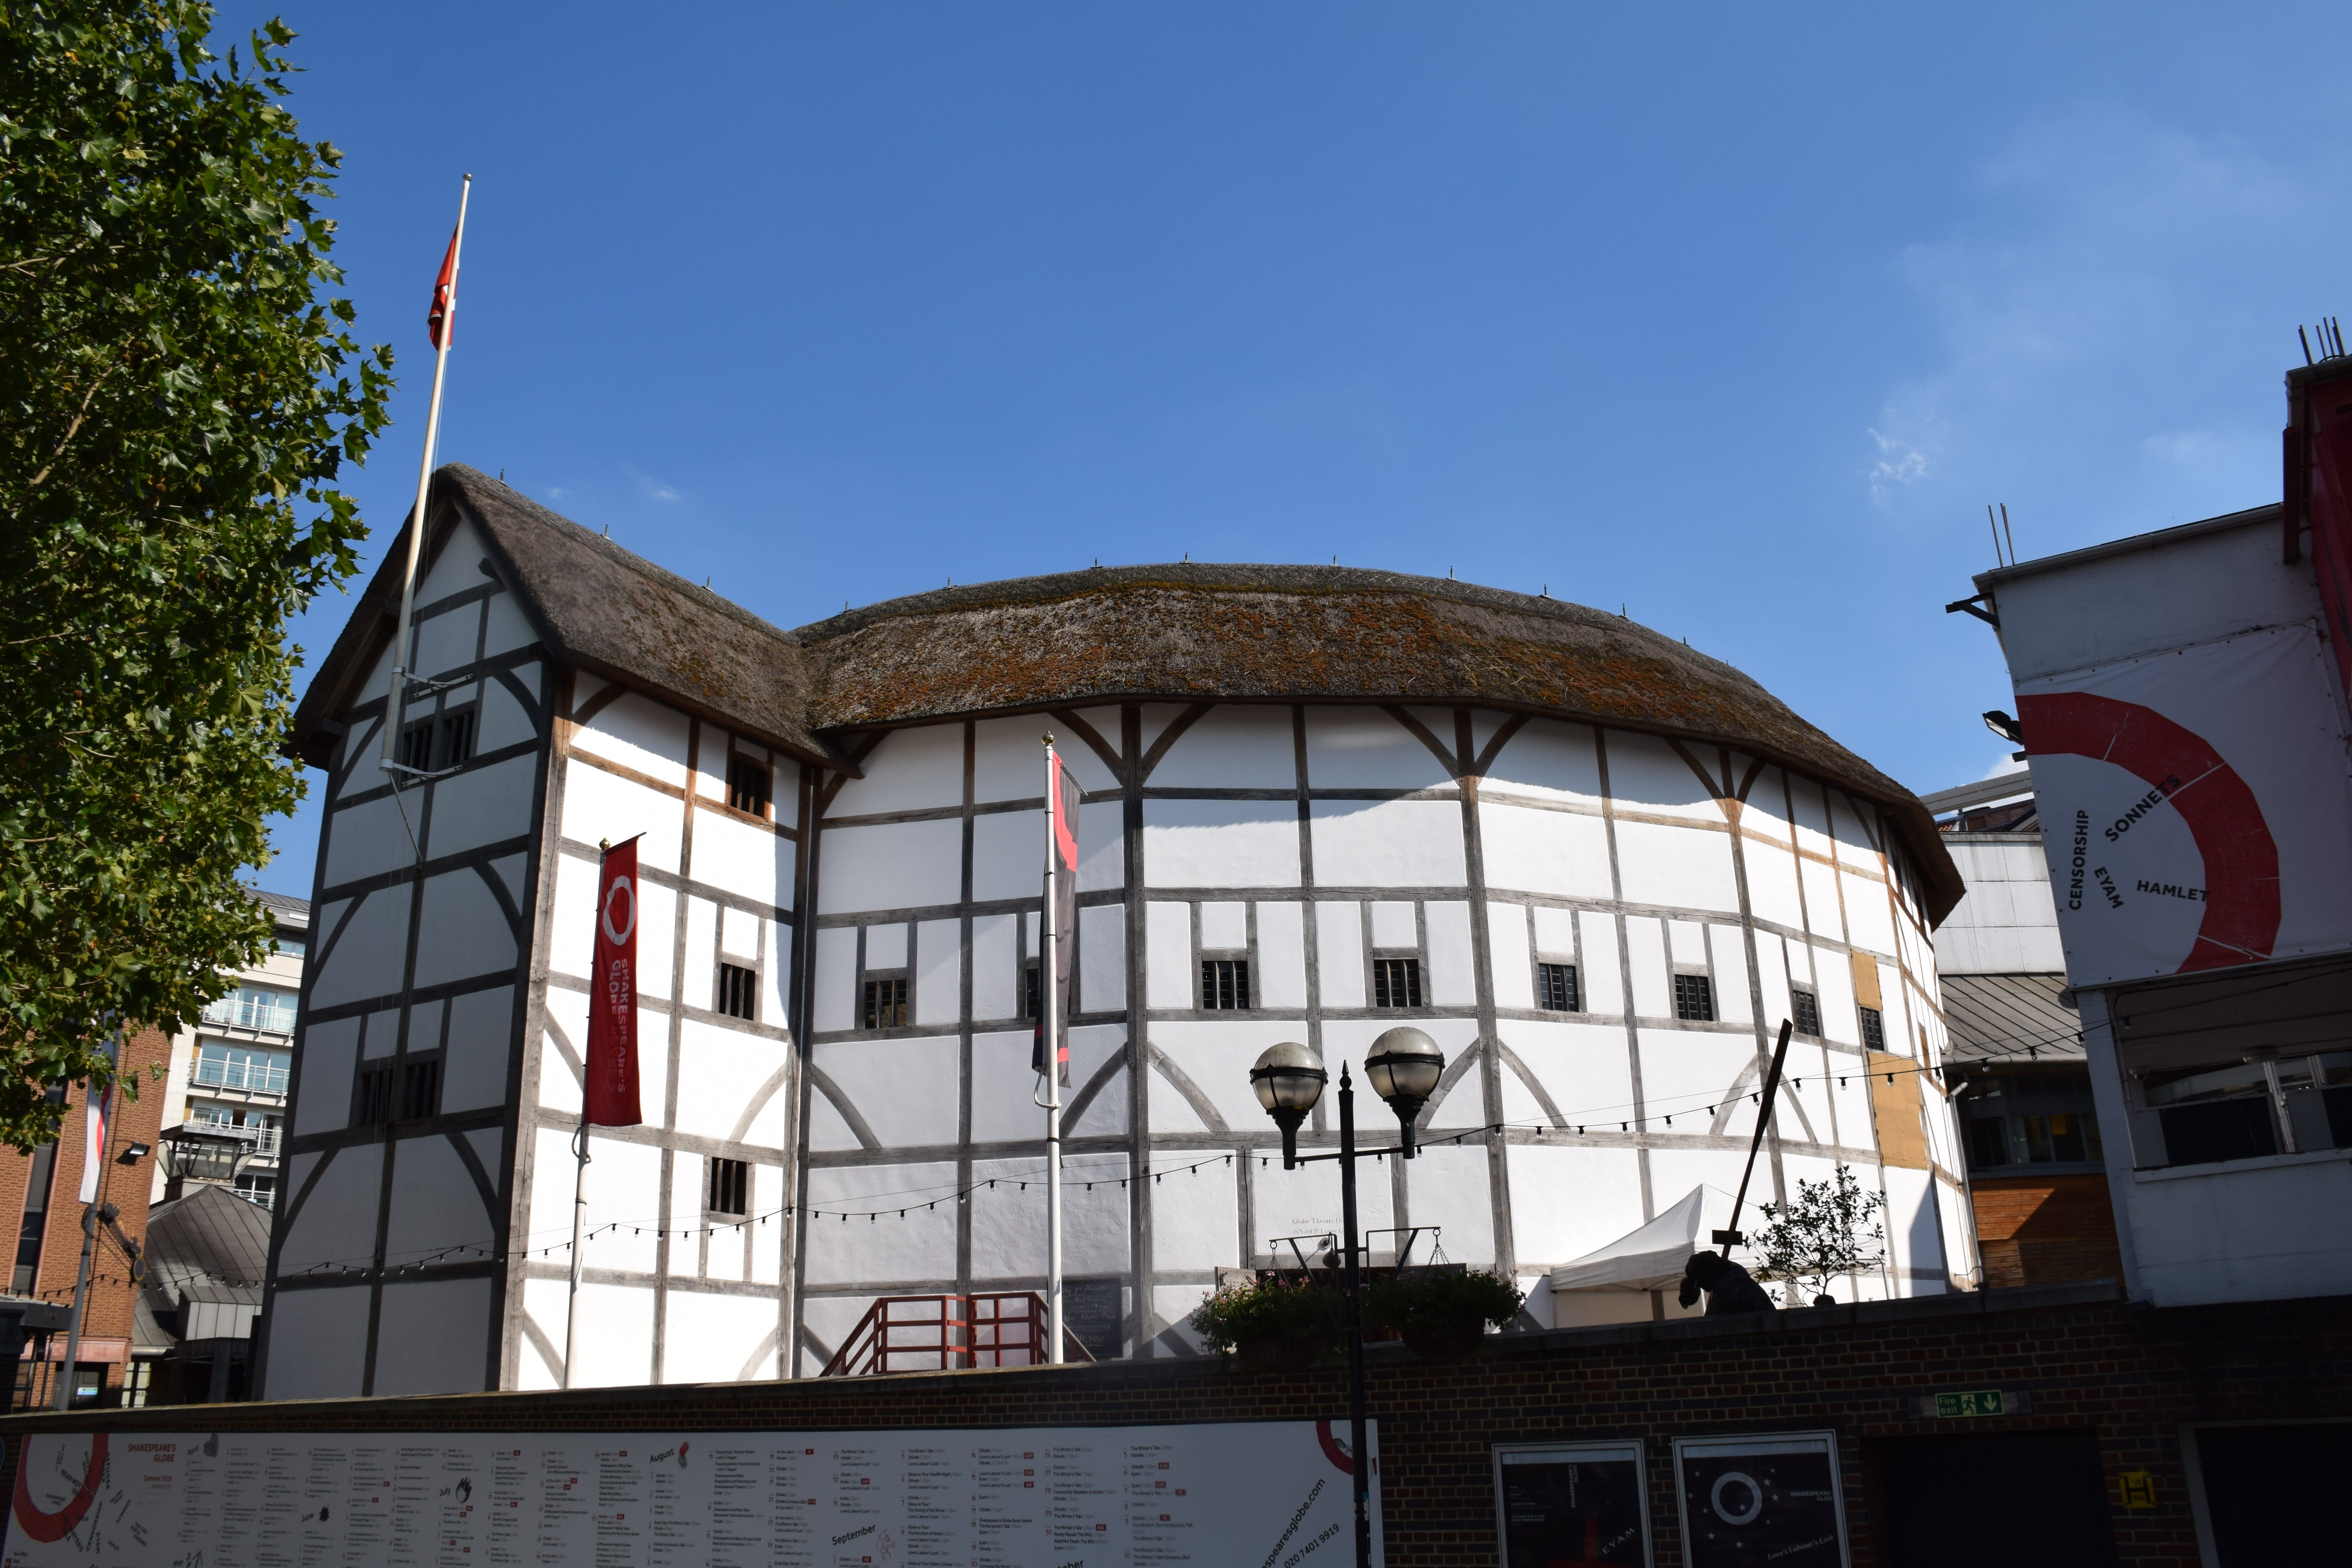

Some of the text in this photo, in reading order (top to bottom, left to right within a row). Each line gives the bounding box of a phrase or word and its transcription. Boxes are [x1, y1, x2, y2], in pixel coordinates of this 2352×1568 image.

[2105, 774, 2181, 842] SONNETS
[2069, 810, 2089, 910] CENSORSHIP
[2094, 867, 2123, 909] EYAM
[2136, 880, 2210, 902] HAMLET
[609, 960, 621, 1015] GLOBE
[618, 958, 629, 1093] SHAKESPEARE'S
[1087, 1334, 1103, 1342] YOU
[188, 1445, 198, 1455] April
[650, 1448, 674, 1463] August
[61, 1469, 72, 1481] READ
[439, 1487, 451, 1497] July
[2124, 1475, 2151, 1504] H
[301, 1513, 314, 1522] June
[1262, 1479, 1325, 1568] spearesglobe.com
[832, 1525, 875, 1545] September
[1285, 1524, 1339, 1568] 020 7401 9919
[1602, 1527, 1635, 1555] EYAM
[1768, 1535, 1834, 1560] Love's Labour's Lost
